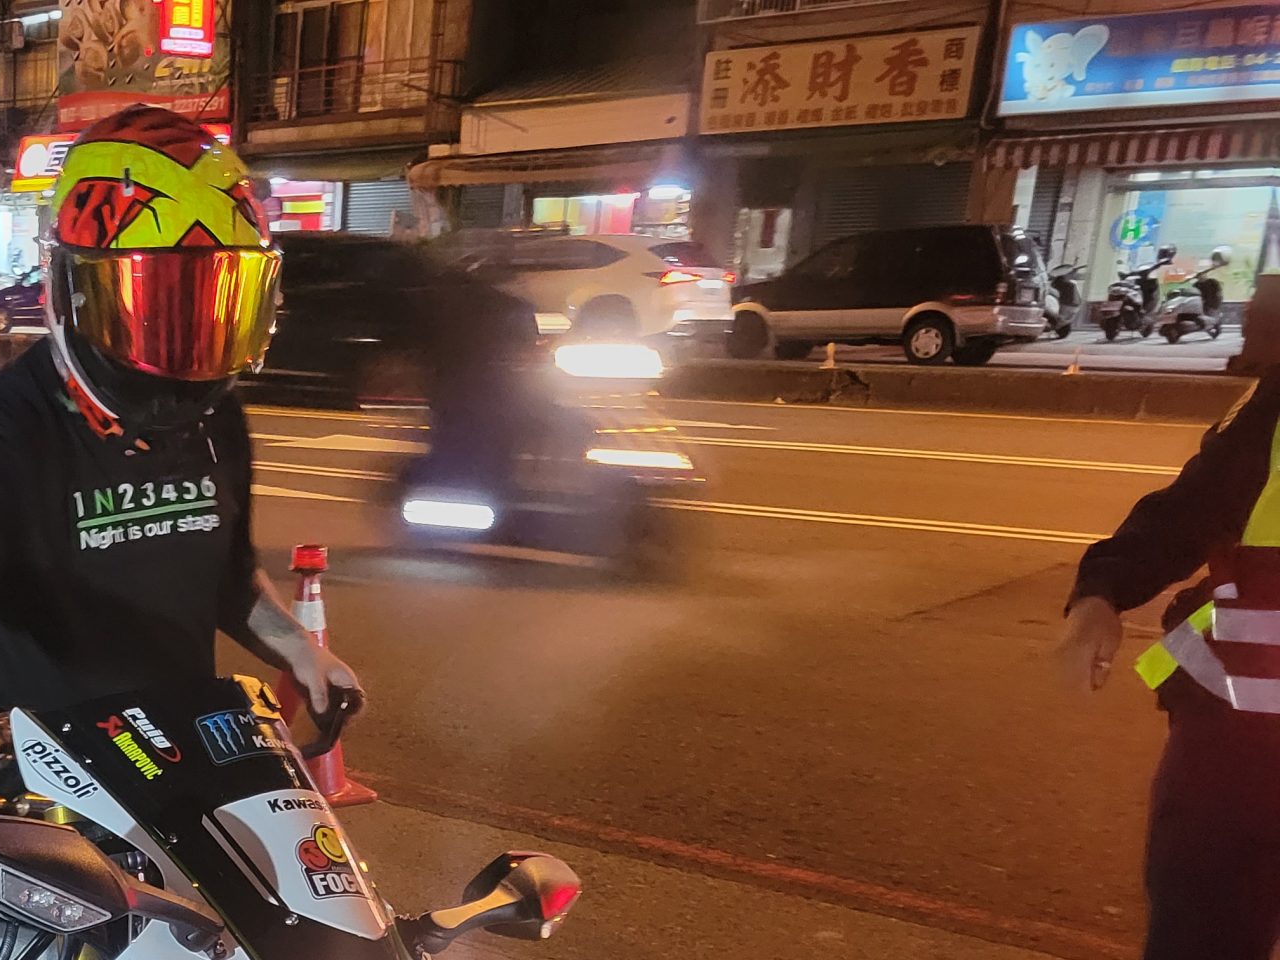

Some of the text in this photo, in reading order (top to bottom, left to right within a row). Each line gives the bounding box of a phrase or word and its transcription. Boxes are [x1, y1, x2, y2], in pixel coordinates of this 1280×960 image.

[740, 37, 930, 107] 添財香
[79, 525, 125, 550] Night
[127, 522, 143, 540] is
[144, 520, 174, 537] our
[124, 707, 172, 749] Puig
[22, 740, 99, 799] pizzoli
